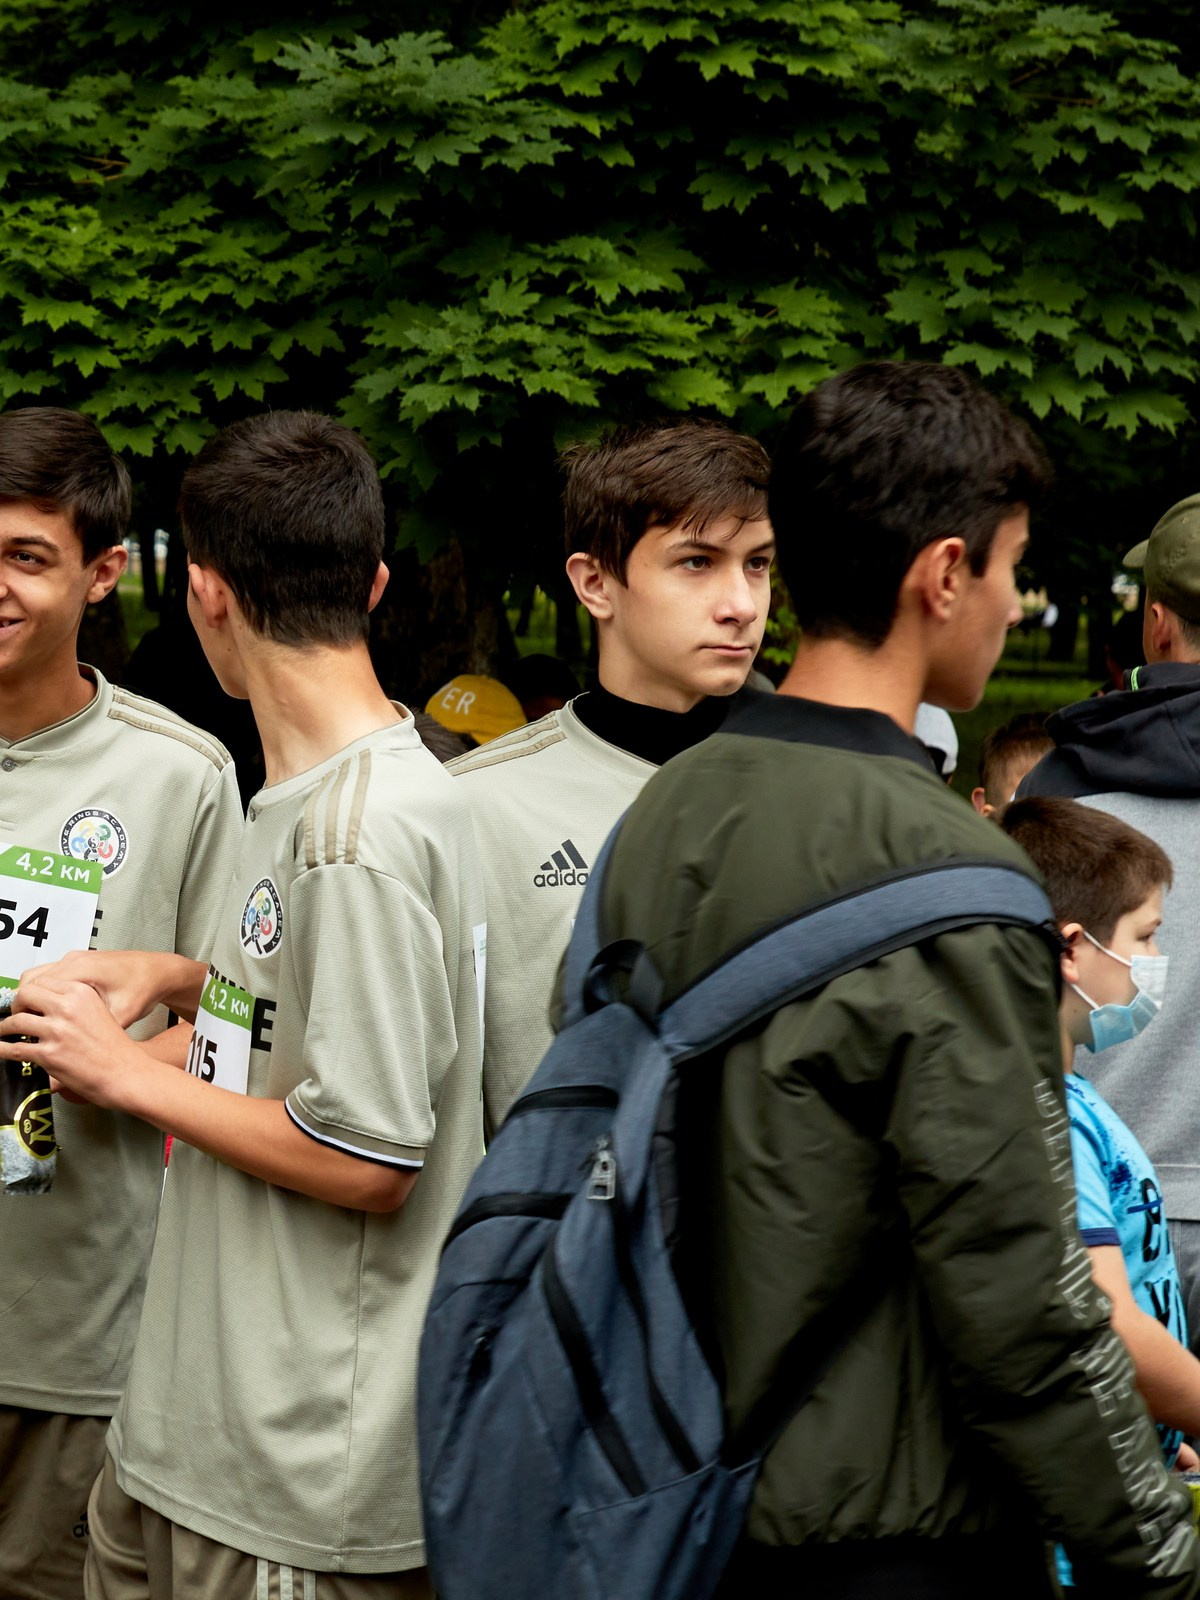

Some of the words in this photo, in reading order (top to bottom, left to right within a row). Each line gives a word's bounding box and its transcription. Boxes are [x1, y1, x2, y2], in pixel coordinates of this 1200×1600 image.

[439, 685, 476, 716] ER
[69, 810, 99, 826] RINGS
[103, 813, 127, 868] ACADEMY
[16, 852, 55, 876] 4,2
[60, 864, 91, 884] КМ
[533, 869, 588, 887] adida
[208, 984, 228, 1011] 4,2
[231, 998, 249, 1019] КМ
[188, 1030, 218, 1084] 115
